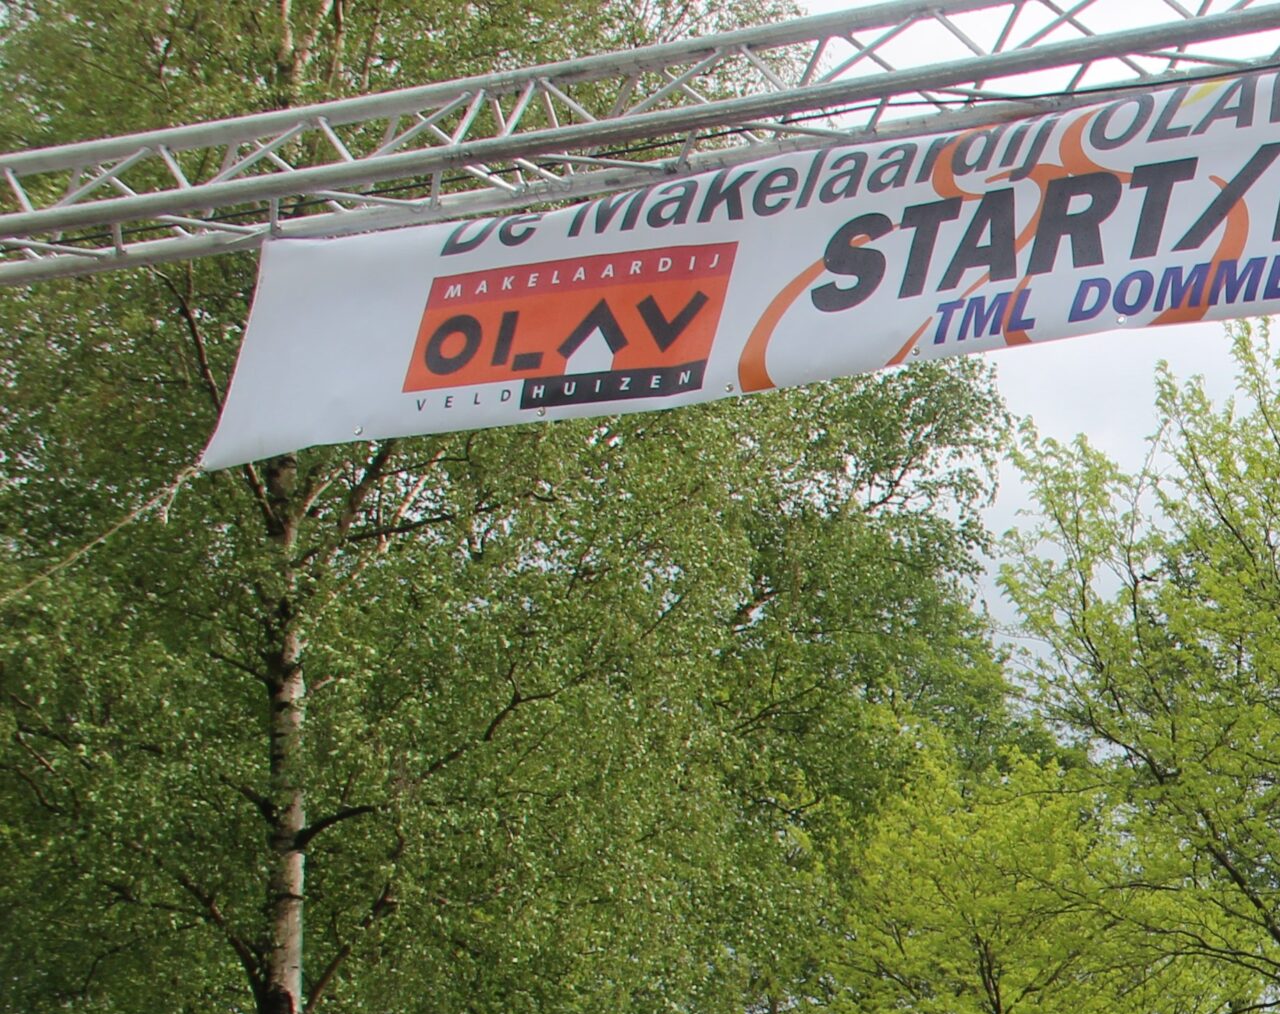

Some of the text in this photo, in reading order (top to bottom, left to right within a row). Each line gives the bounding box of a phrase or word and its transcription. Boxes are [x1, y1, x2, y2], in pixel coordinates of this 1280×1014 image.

[443, 251, 724, 300] MAKELAARDIJ
[422, 288, 711, 376] OLAV
[931, 291, 1036, 346] TML
